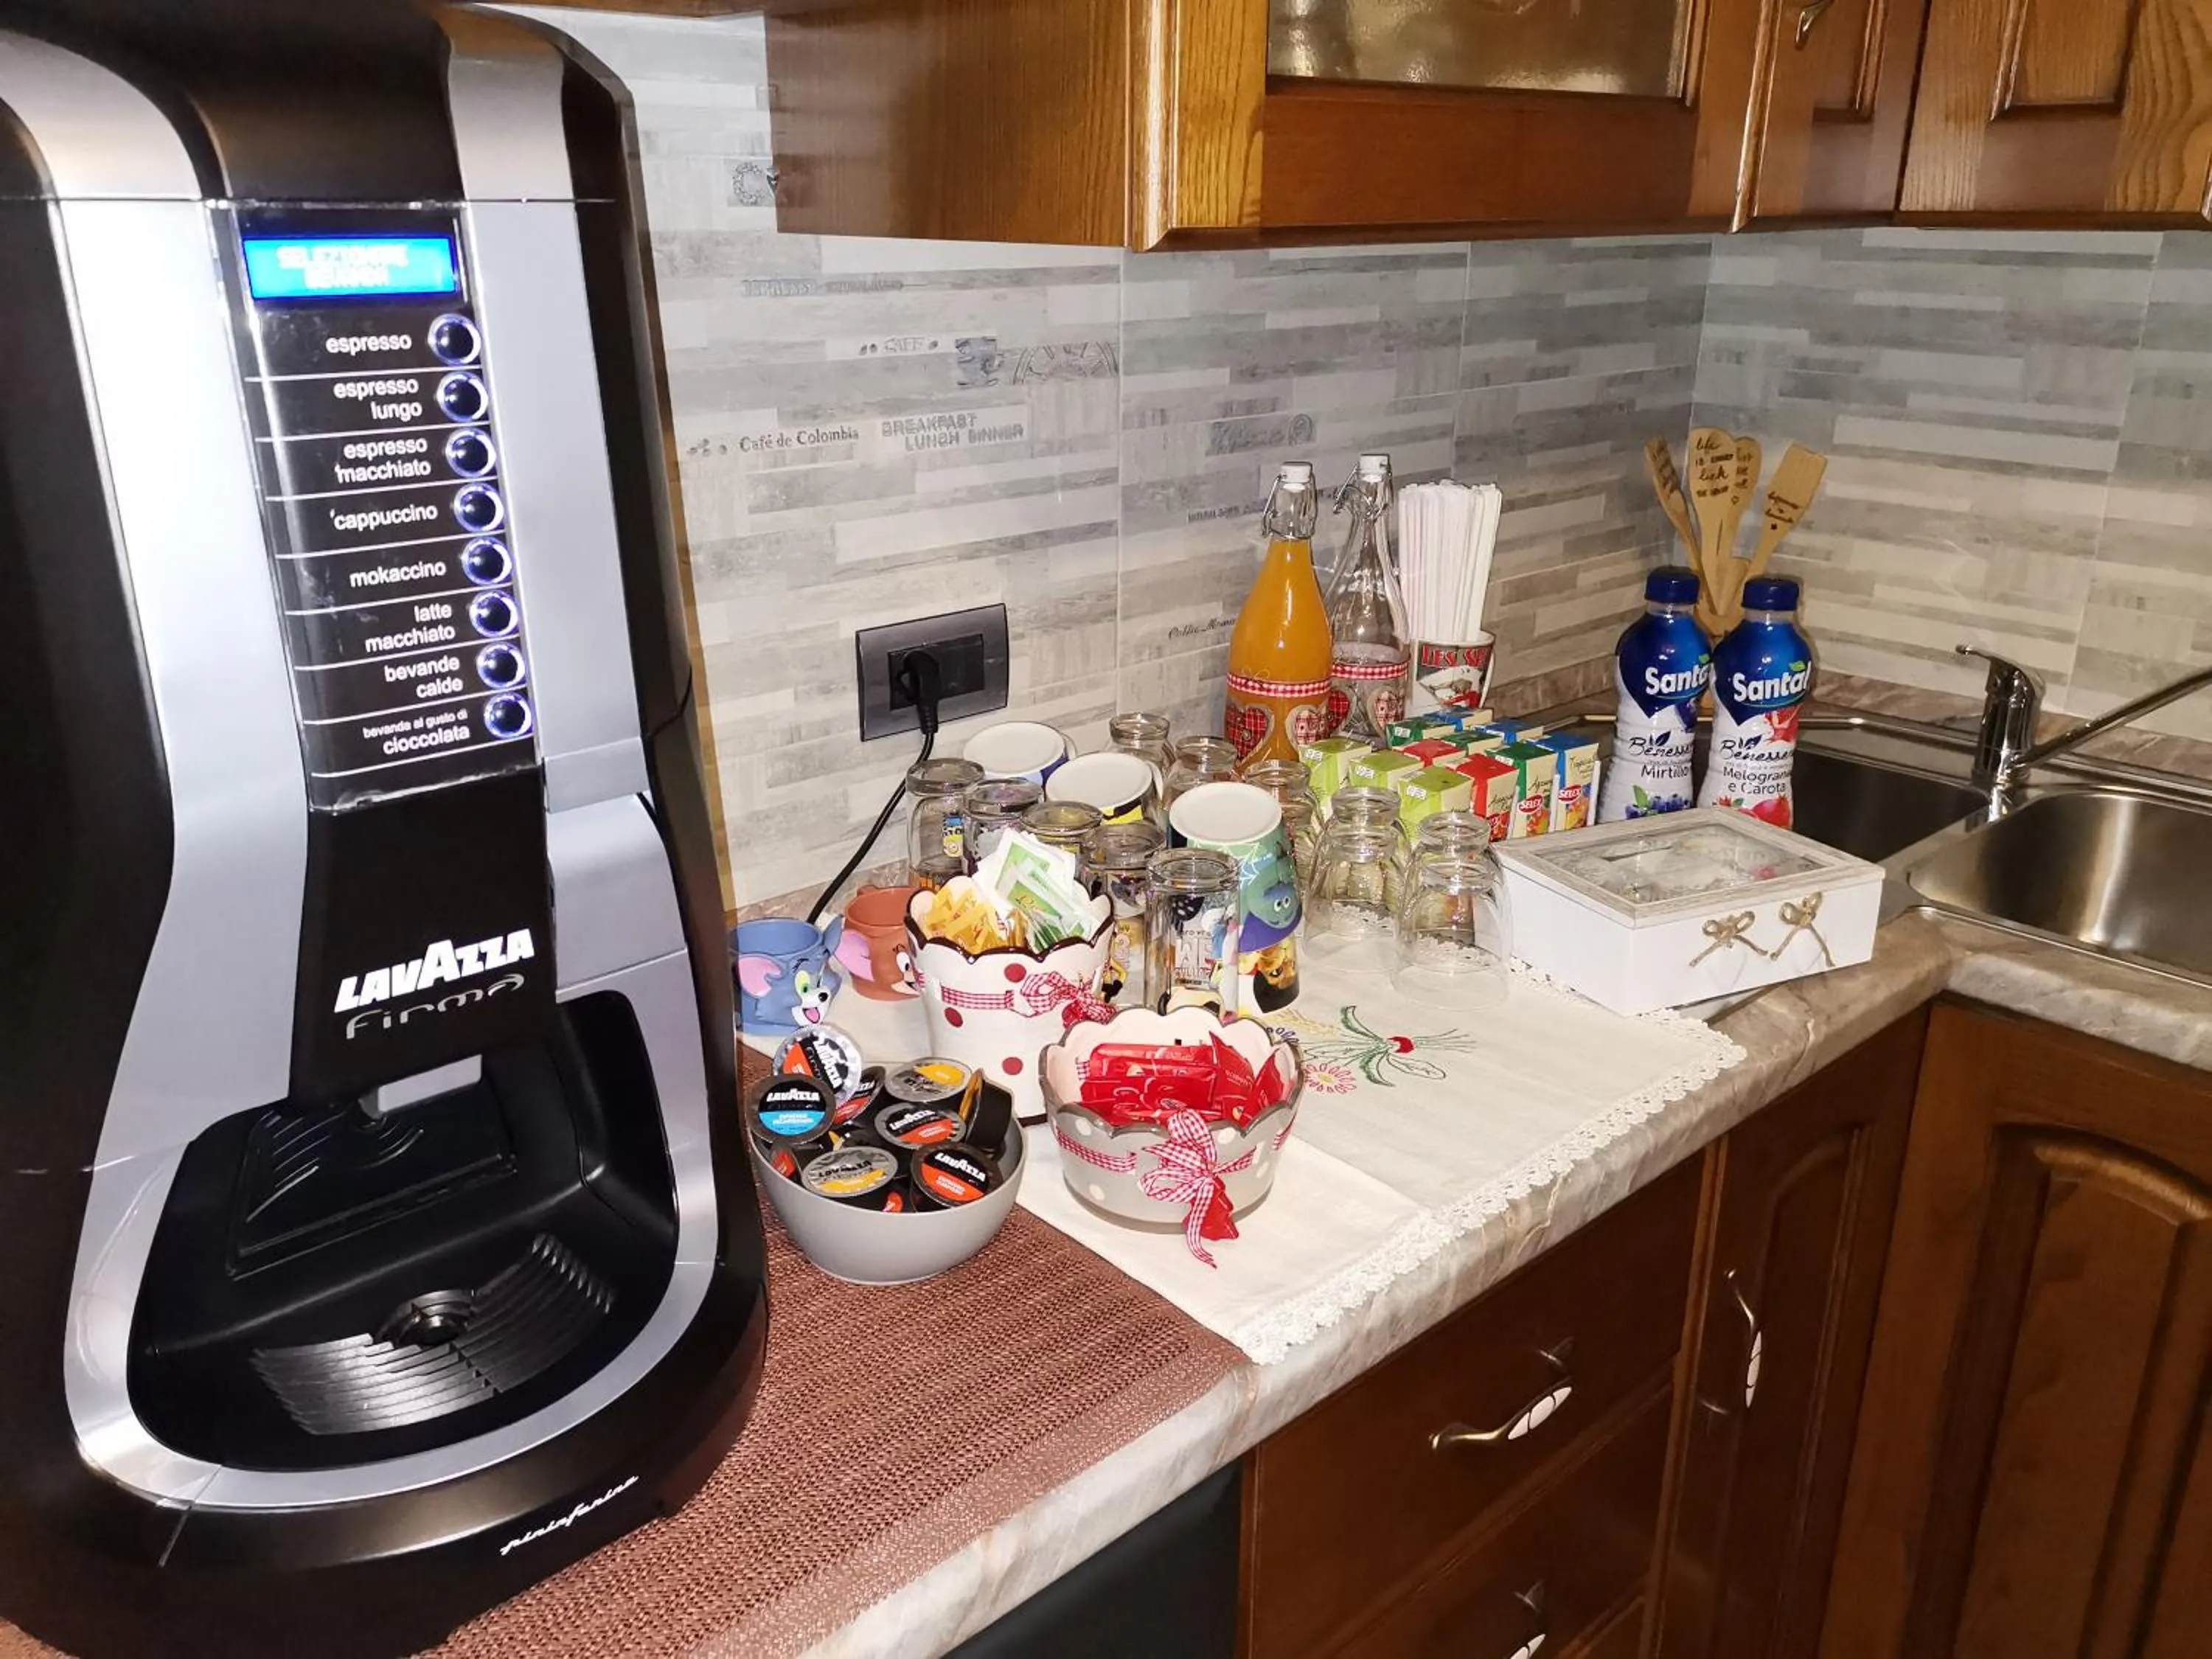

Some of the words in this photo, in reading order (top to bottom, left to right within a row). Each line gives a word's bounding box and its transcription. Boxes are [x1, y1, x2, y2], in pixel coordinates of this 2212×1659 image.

[326, 333, 412, 355] espresso
[333, 378, 419, 400] espresso
[371, 397, 422, 422] lungo
[344, 437, 428, 459] espresso
[776, 432, 793, 448] de
[797, 425, 859, 446] Colombia
[337, 460, 431, 484] macchiato
[333, 504, 438, 532] cappuccino
[349, 560, 446, 587] mokaccino
[414, 603, 452, 622] latte
[365, 625, 456, 653] macchiato
[384, 655, 460, 682] bevande
[1733, 660, 1812, 702] Santal
[417, 675, 463, 698] calde
[383, 725, 470, 754] cioccolata
[334, 928, 535, 1013] LAVAZZA
[766, 1088, 821, 1102] LAVAZZA
[933, 1152, 987, 1183] LAVAZZA
